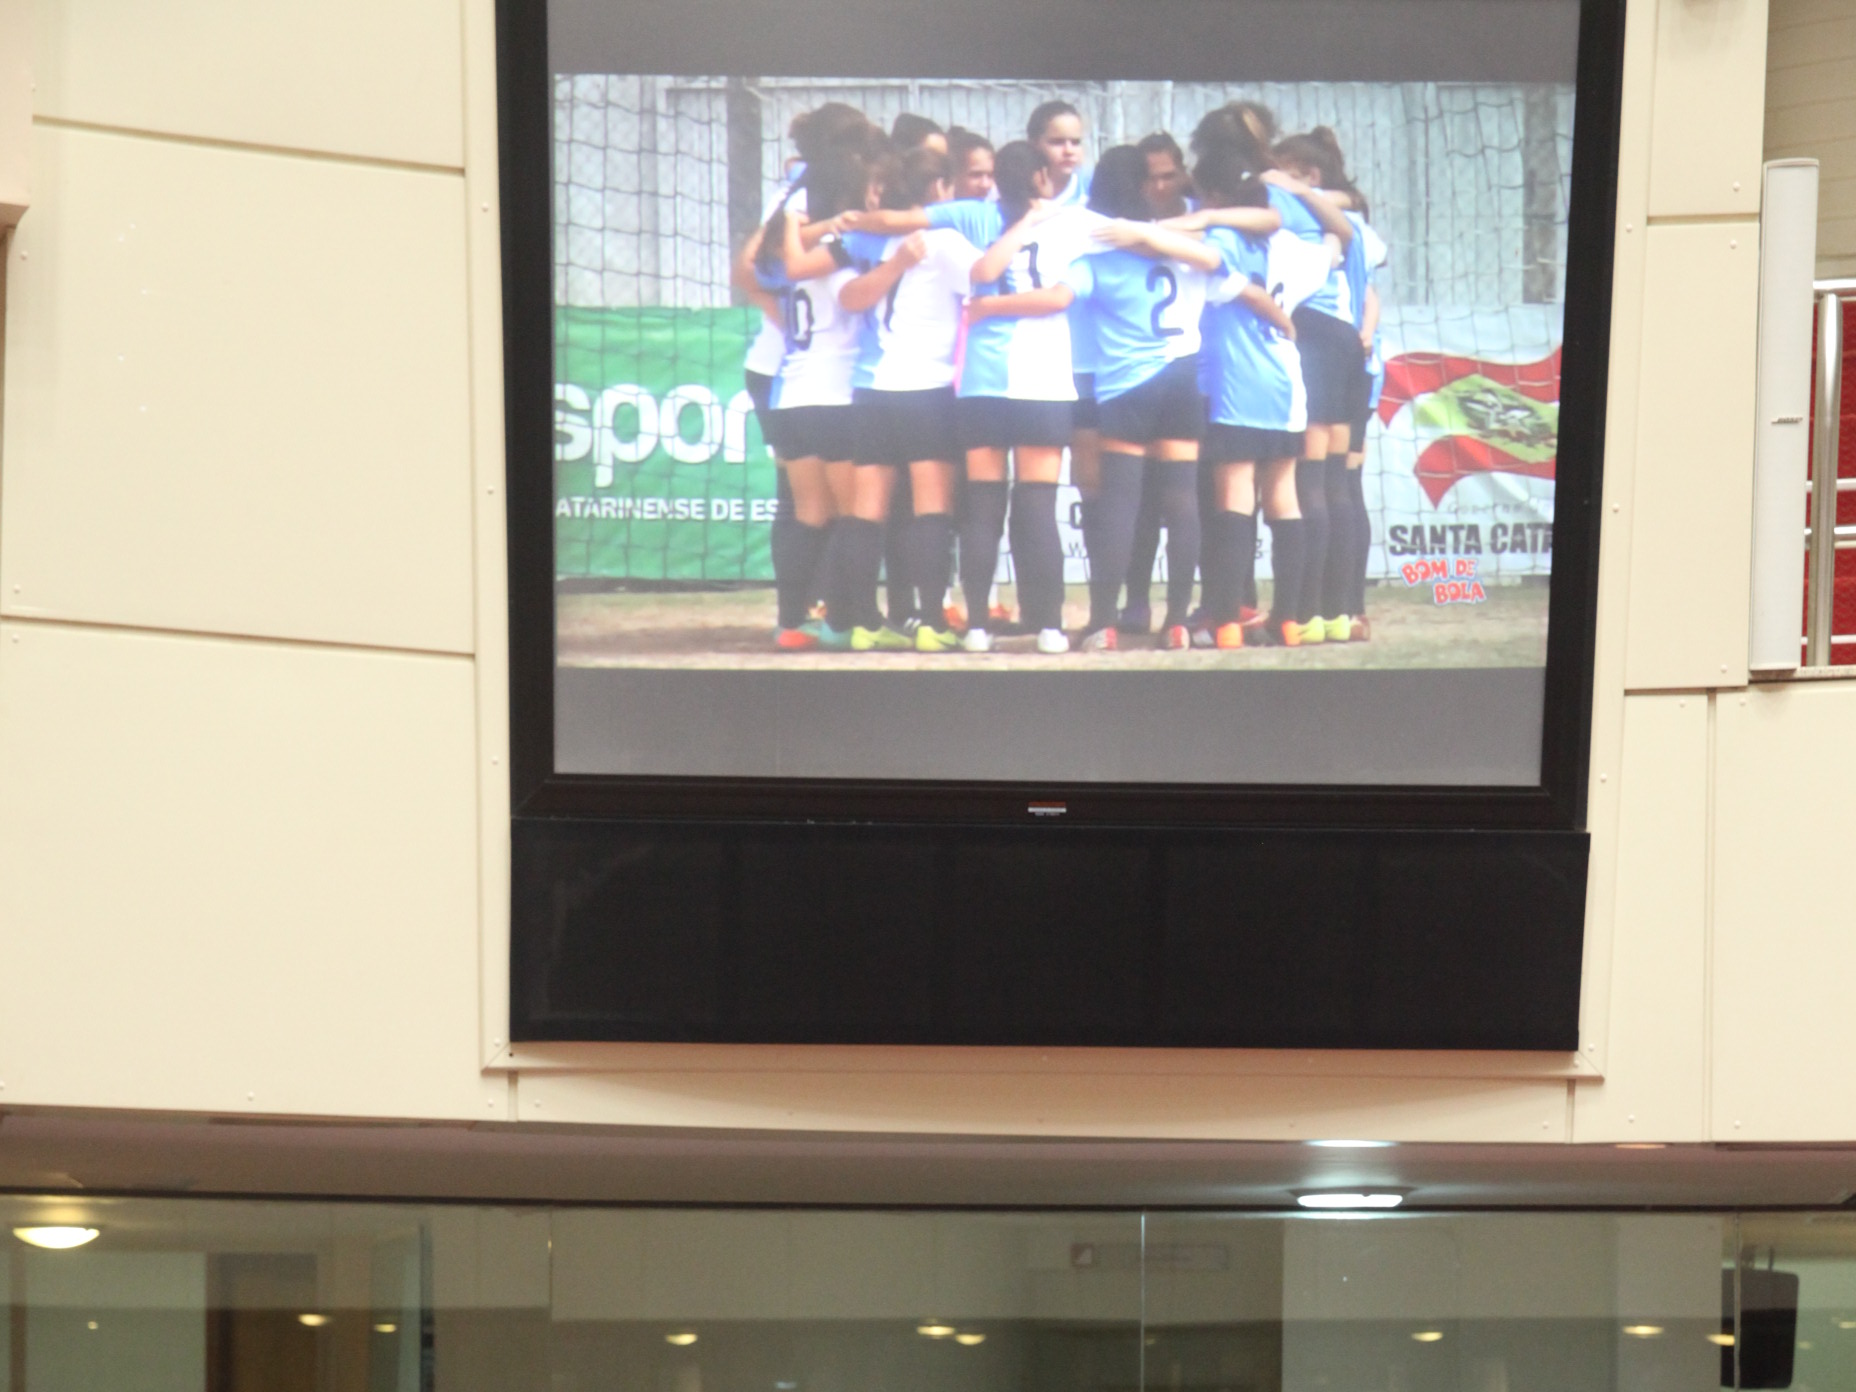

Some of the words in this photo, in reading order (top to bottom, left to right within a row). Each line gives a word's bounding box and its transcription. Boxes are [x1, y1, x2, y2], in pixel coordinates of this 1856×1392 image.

[1146, 265, 1184, 338] 2
[555, 384, 774, 487] spor
[711, 499, 745, 521] DE
[1389, 523, 1482, 556] SANTA
[1402, 558, 1448, 585] BOM
[1455, 558, 1477, 577] DE
[1435, 580, 1485, 604] BOLA
